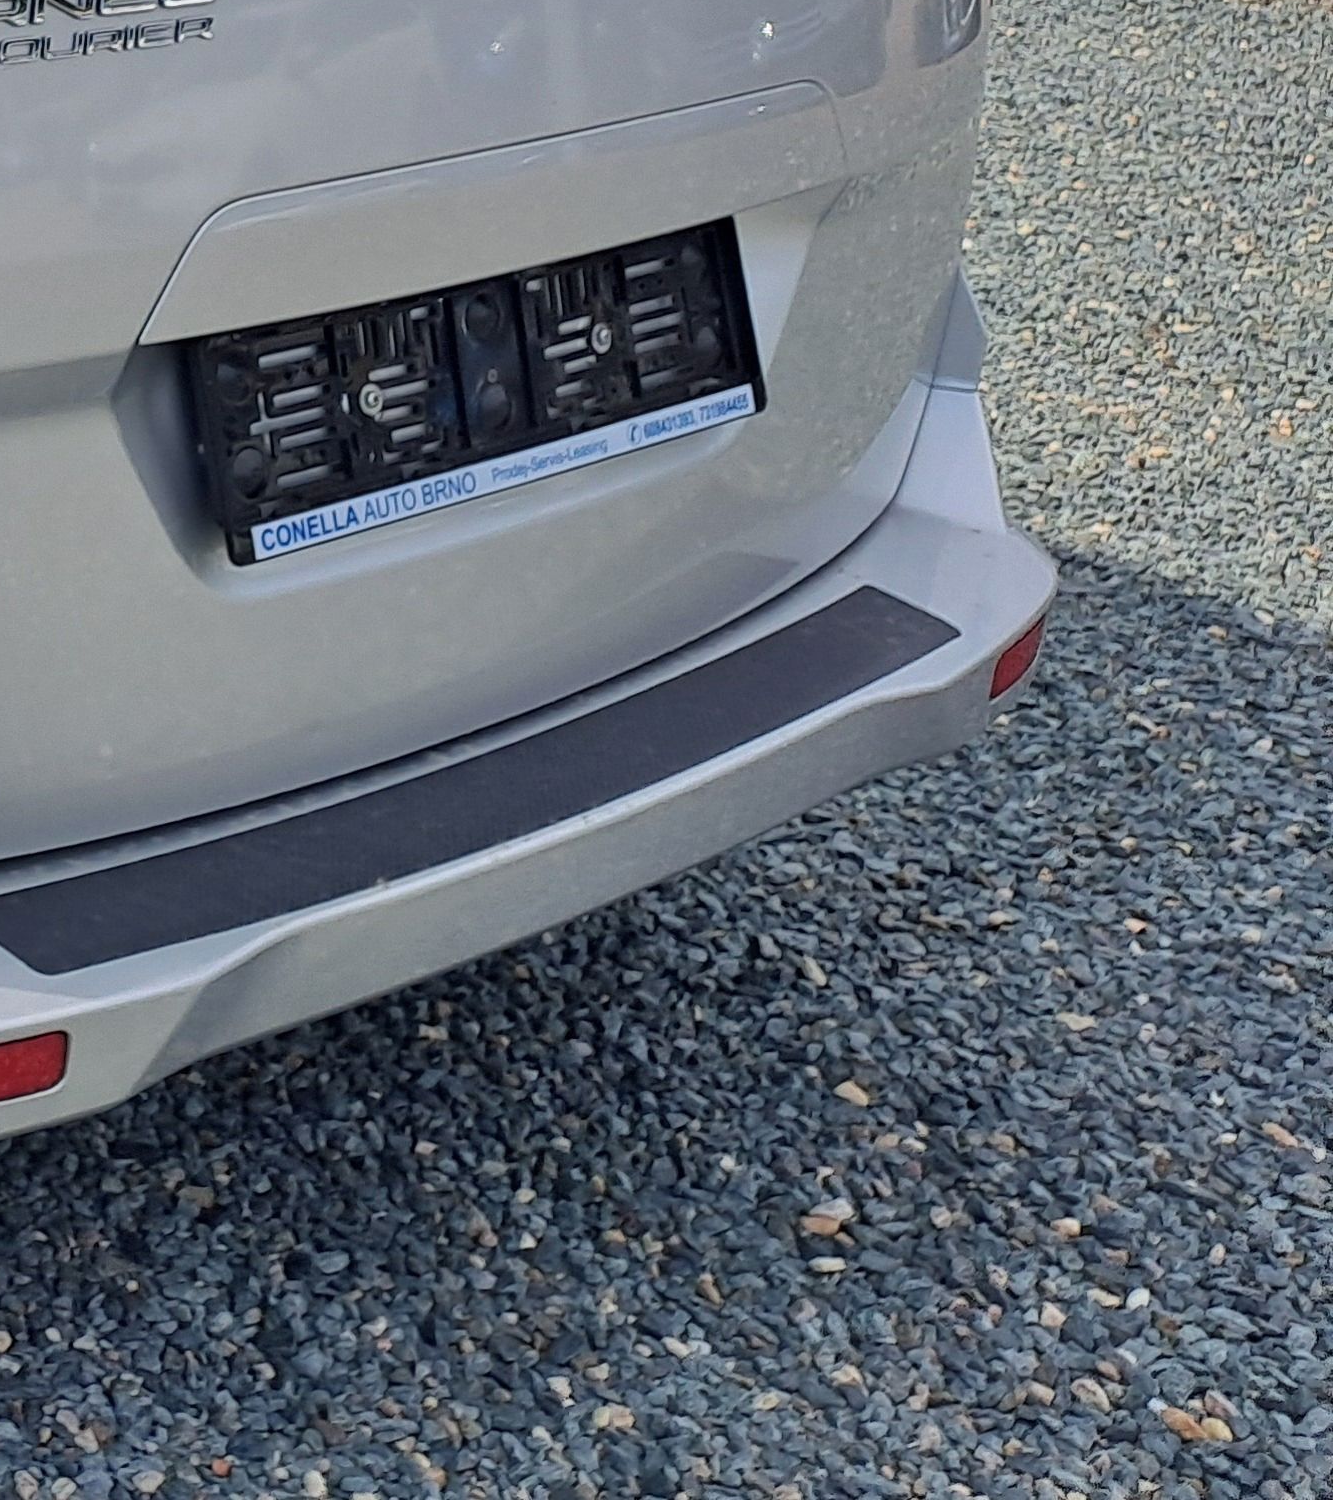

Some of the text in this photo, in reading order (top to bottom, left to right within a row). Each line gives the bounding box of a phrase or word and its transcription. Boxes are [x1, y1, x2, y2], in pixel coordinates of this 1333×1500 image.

[260, 506, 360, 551] CONELLA
[363, 487, 417, 524] AUTO
[422, 471, 477, 507] BRNO
